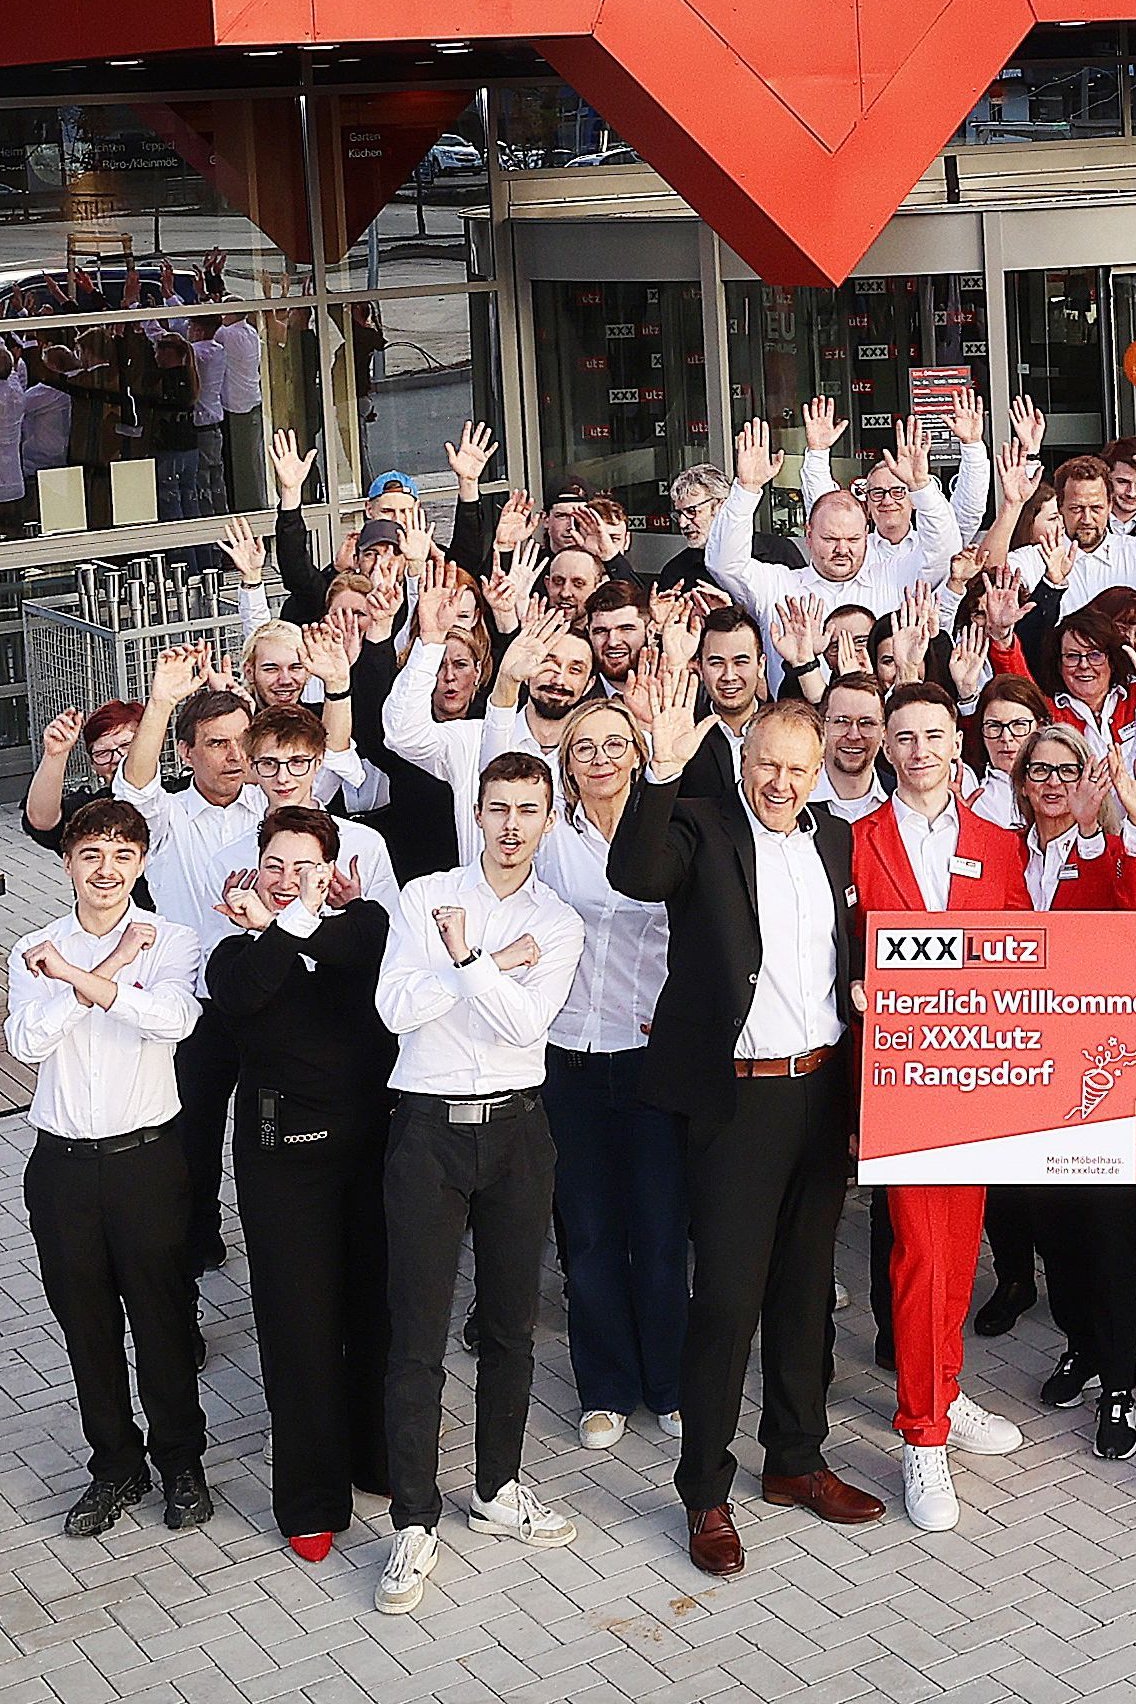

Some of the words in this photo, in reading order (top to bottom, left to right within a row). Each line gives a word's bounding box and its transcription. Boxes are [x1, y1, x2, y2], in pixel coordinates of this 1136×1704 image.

[885, 935, 1038, 962] XXXLutz
[875, 990, 986, 1014] Herzlich
[874, 1027, 914, 1050] bei
[919, 1027, 1041, 1049] XXXLutz
[873, 1063, 896, 1086] in
[904, 1060, 1054, 1091] Rangsdorf
[1046, 1156, 1069, 1164] Mein
[1071, 1155, 1124, 1165] Möbelhaus.
[1046, 1166, 1069, 1174] Mein
[1071, 1166, 1120, 1175] xxxlutz.de
